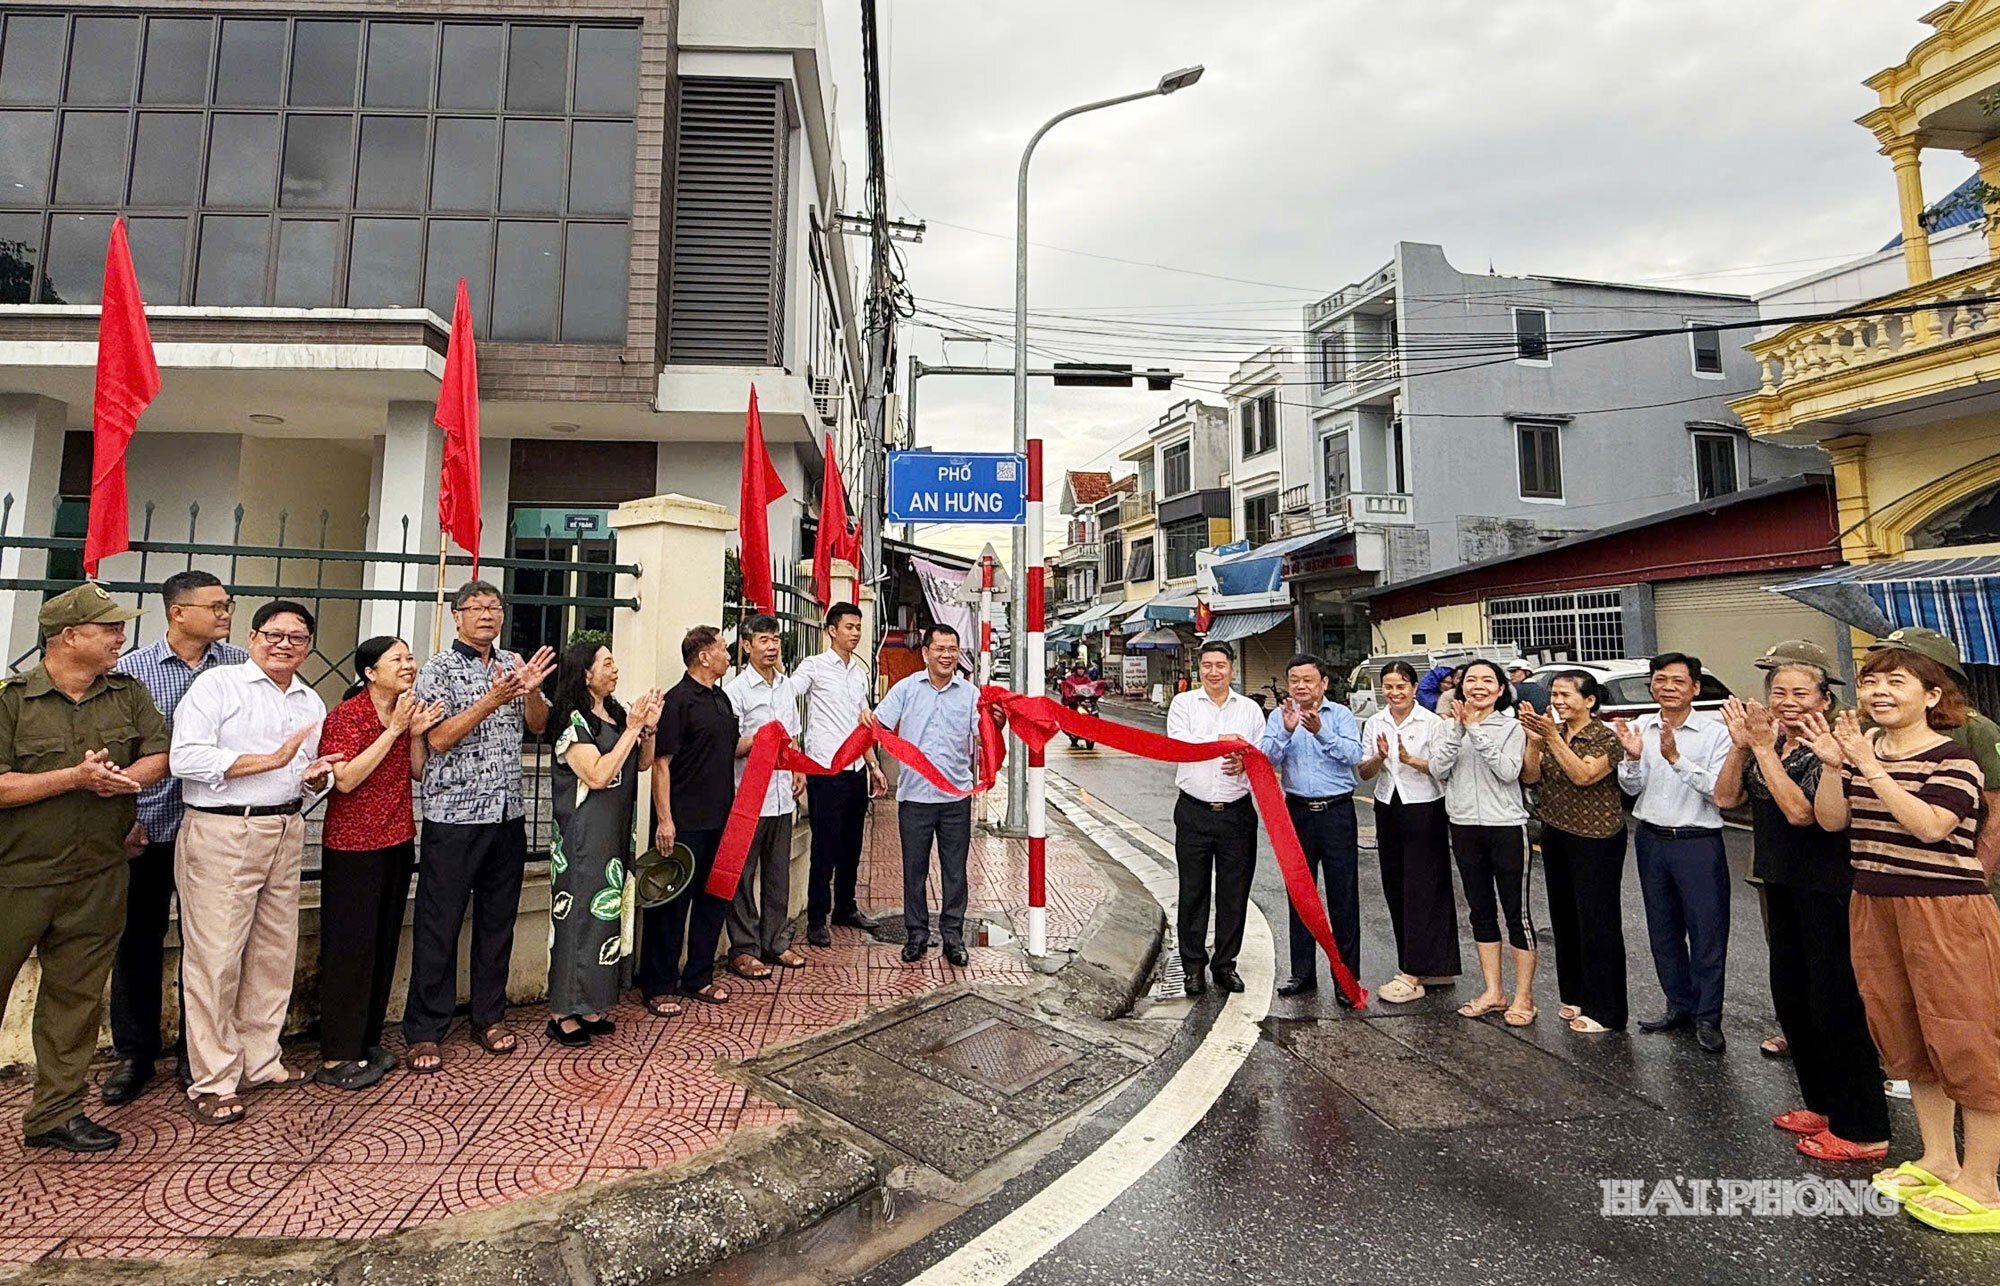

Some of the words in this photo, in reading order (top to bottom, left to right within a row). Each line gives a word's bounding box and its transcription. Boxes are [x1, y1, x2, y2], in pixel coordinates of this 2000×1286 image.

[938, 462, 972, 481] PHỐ
[909, 492, 938, 512] AN
[945, 491, 1002, 512] HƯNG
